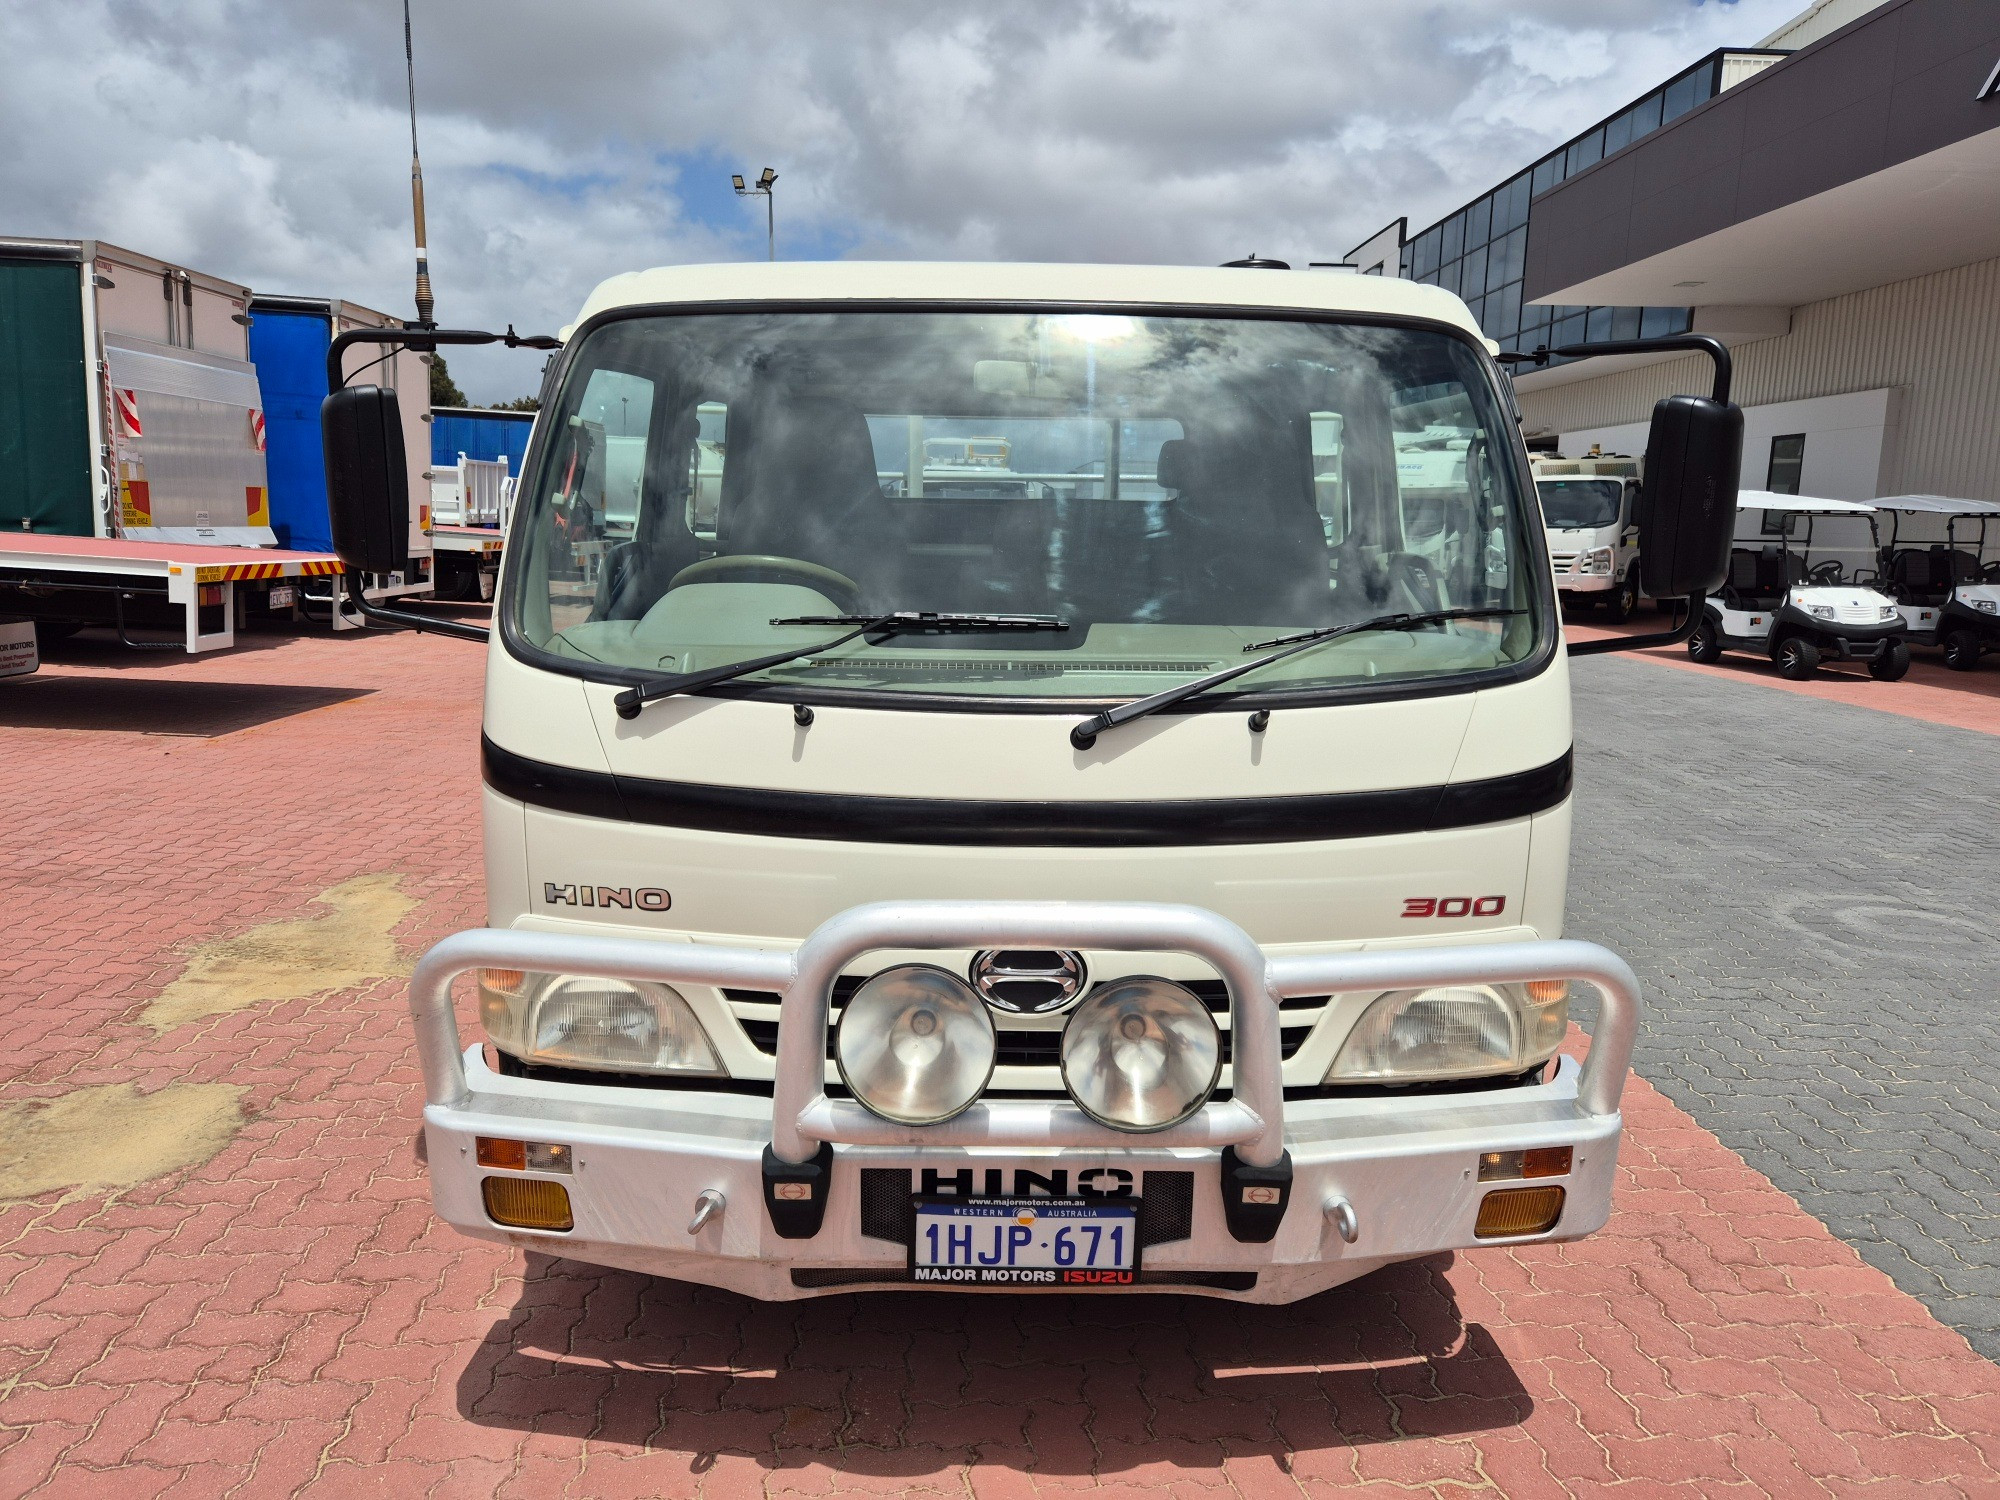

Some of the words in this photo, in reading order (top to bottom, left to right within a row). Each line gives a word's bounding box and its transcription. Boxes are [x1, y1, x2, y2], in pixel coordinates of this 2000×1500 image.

[10, 641, 35, 650] MOTORS
[544, 882, 672, 912] HINO
[1400, 895, 1506, 917] 300
[921, 1168, 1134, 1197] HINO
[968, 1198, 1086, 1207] www.majormotors.com.au
[953, 1208, 1004, 1217] WESTERN
[1047, 1209, 1098, 1218] AUSTRALIA
[915, 1268, 977, 1281] MAJOR
[981, 1269, 1056, 1282] MOTORS
[1063, 1270, 1133, 1284] ISUZU
